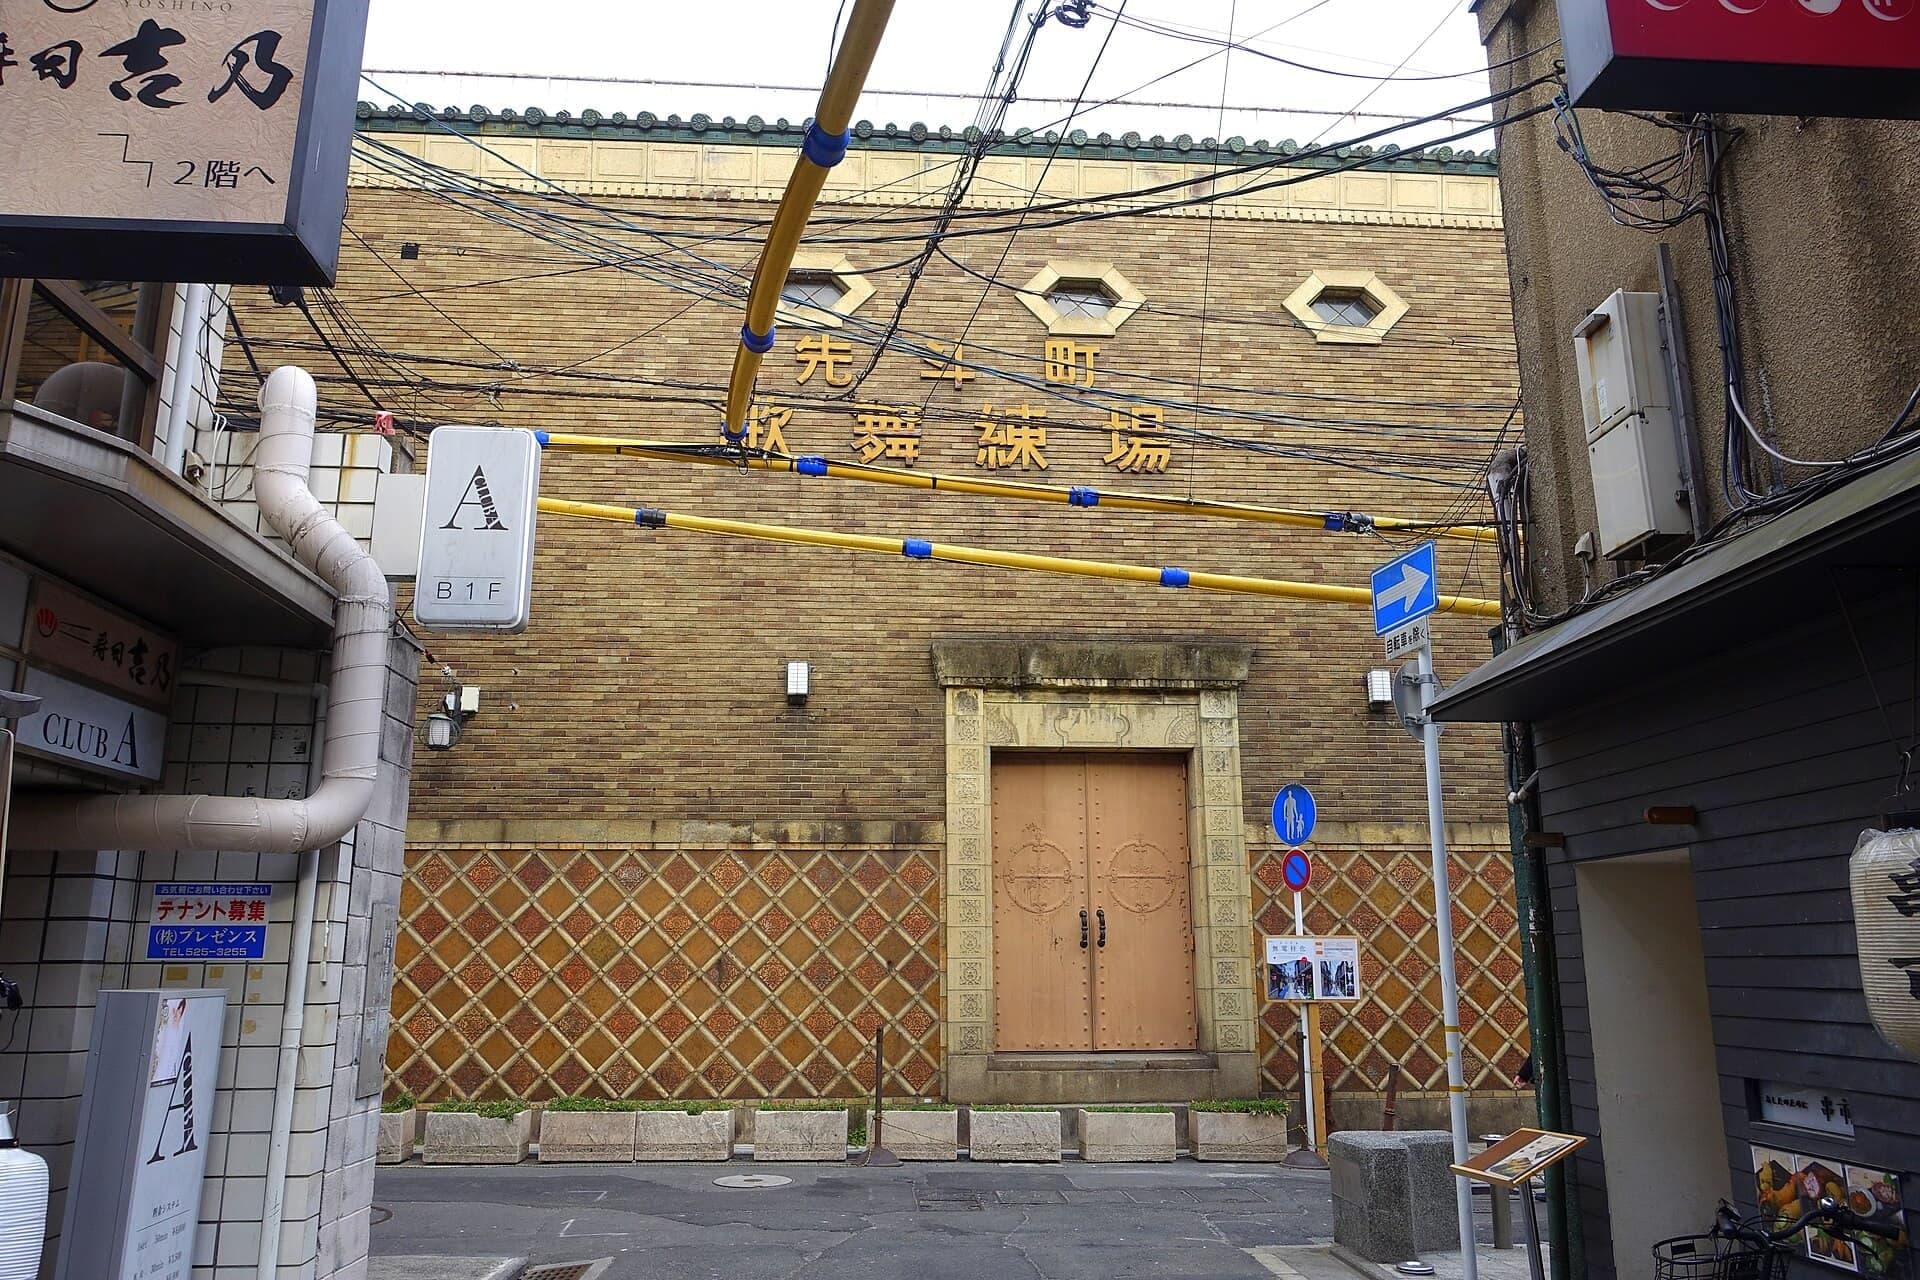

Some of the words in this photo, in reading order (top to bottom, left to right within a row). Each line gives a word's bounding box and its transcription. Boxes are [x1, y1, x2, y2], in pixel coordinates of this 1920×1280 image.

[173, 160, 276, 190] 2階へ
[795, 333, 1101, 390] 先斗町
[1387, 626, 1425, 654] 自転車を除く
[42, 712, 109, 760] CLUB
[111, 710, 140, 769] A
[157, 899, 266, 922] テナント募集
[154, 927, 257, 945] (株)プレゼンス
